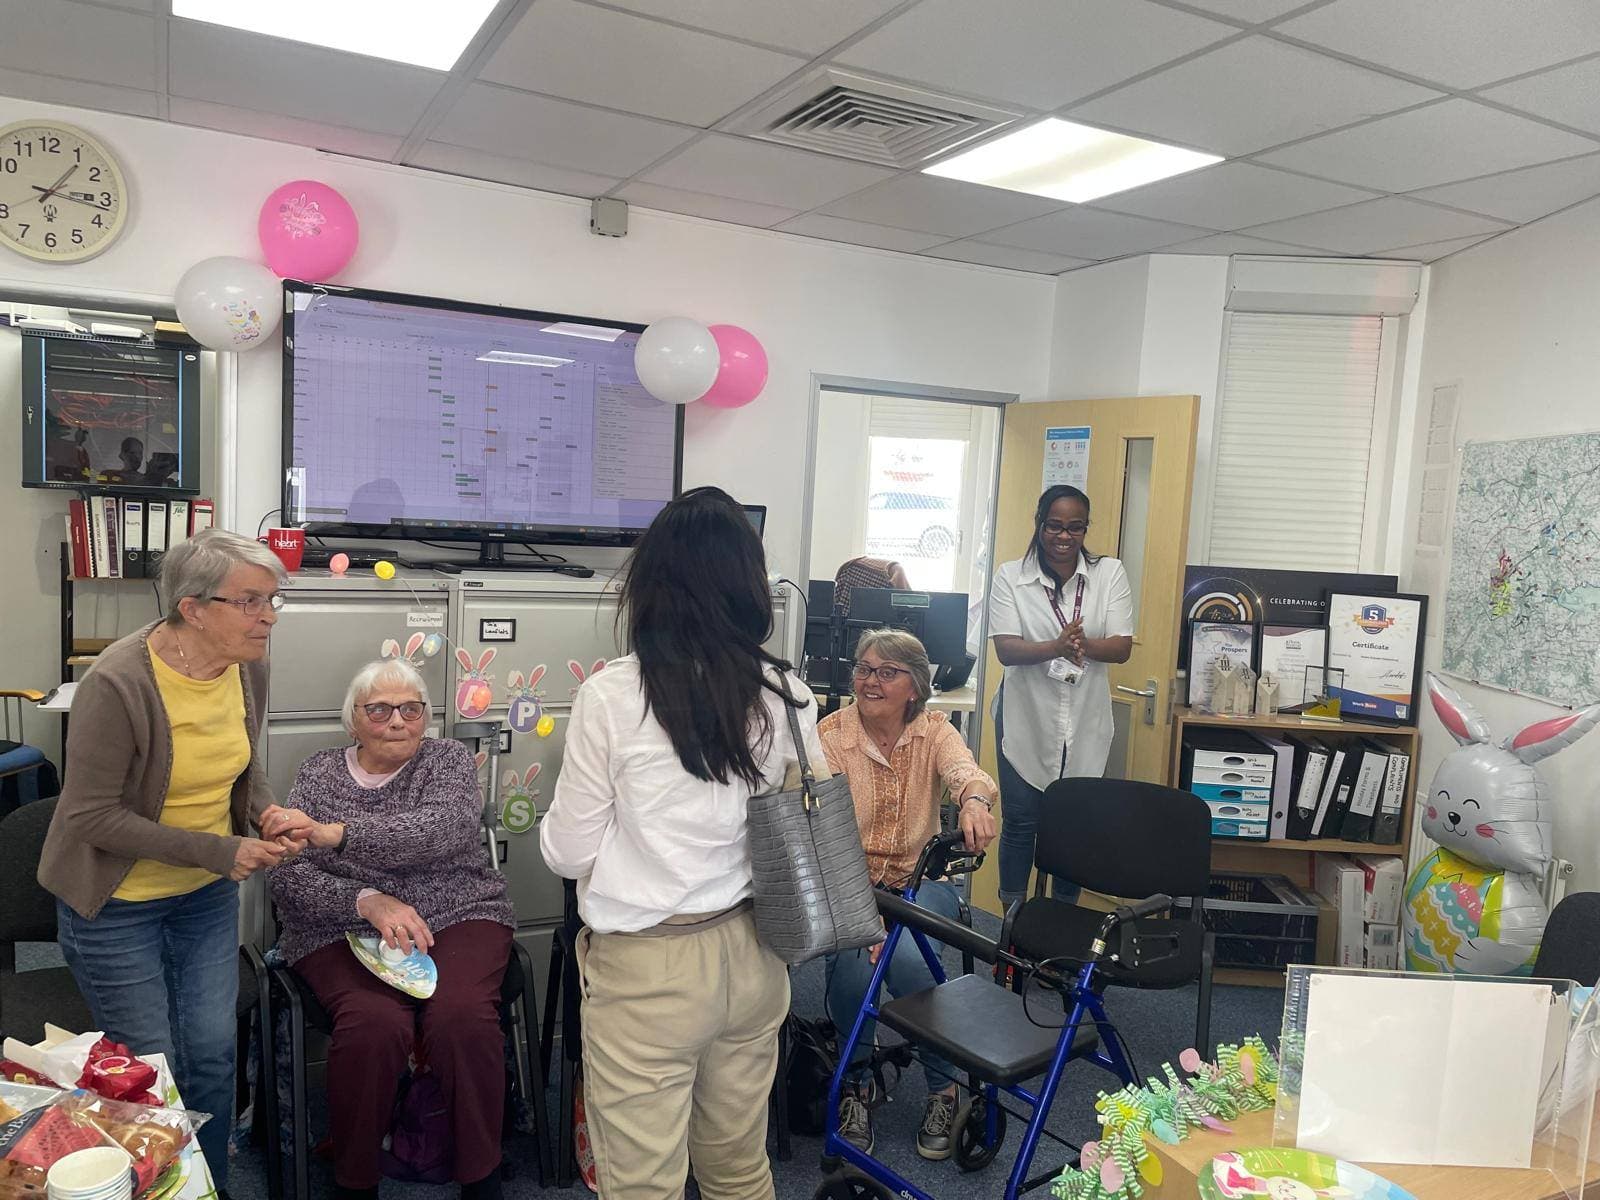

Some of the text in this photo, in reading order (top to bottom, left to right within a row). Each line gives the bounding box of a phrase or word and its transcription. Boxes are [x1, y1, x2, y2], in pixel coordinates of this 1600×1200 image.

[13, 140, 32, 157] 11
[38, 136, 61, 154] 12
[73, 147, 81, 163] 1
[89, 166, 101, 182] 2
[100, 192, 112, 207] 3
[91, 214, 103, 228] 4
[18, 223, 31, 239] 7
[71, 229, 83, 244] 5
[45, 232, 57, 248] 6
[1269, 597, 1318, 607] CELEBRATING
[1352, 641, 1390, 651] Certificate
[517, 702, 536, 727] P
[508, 800, 530, 826] S
